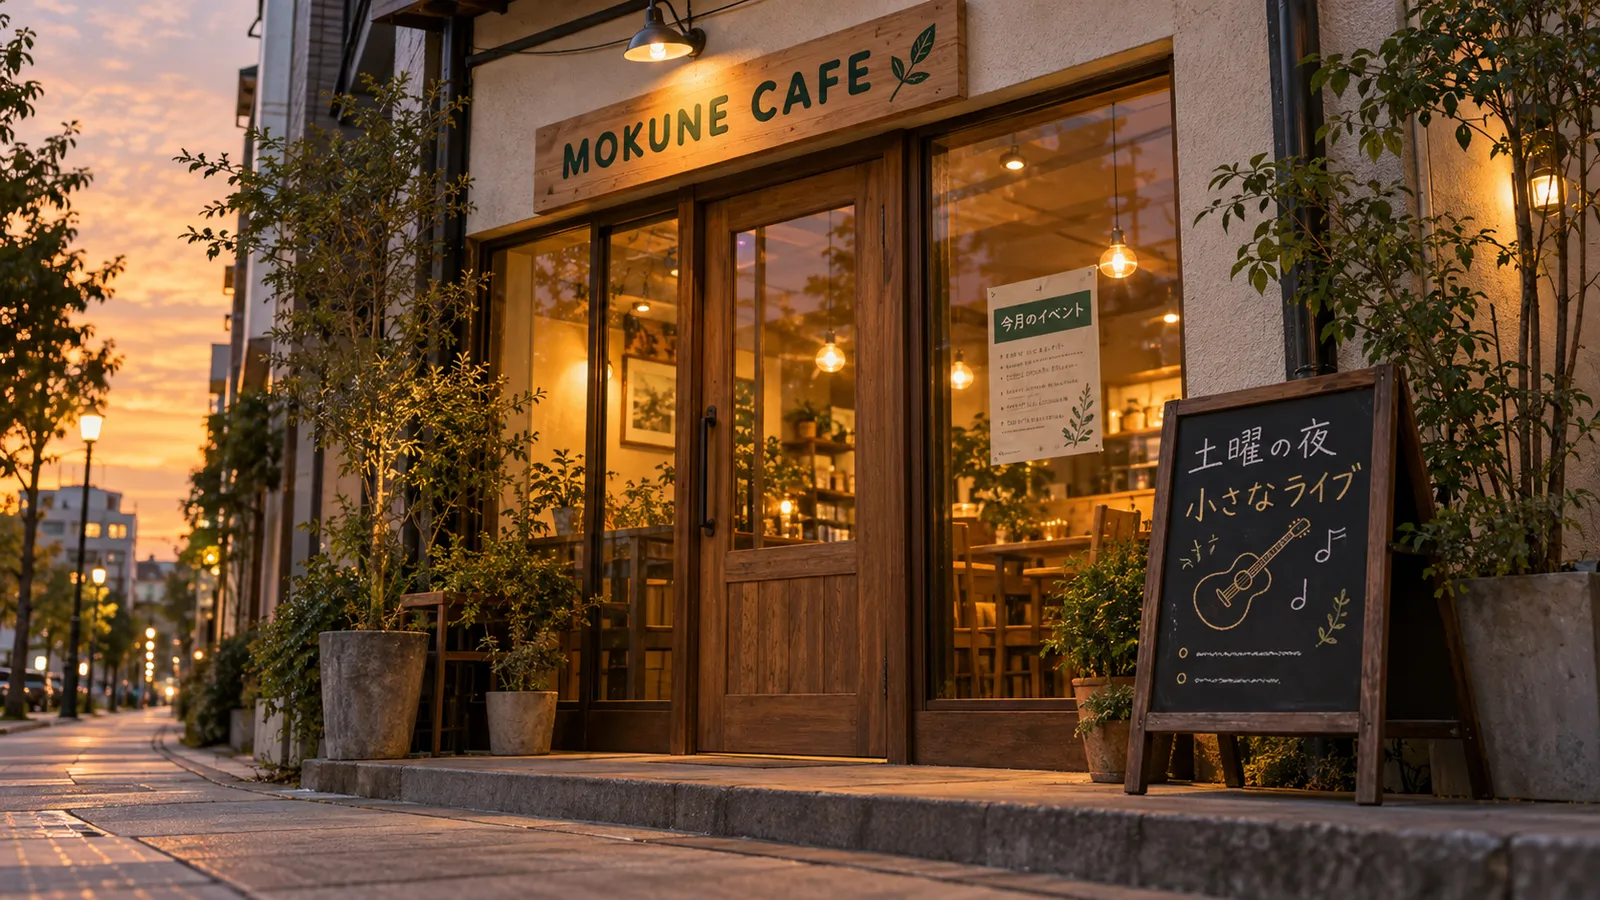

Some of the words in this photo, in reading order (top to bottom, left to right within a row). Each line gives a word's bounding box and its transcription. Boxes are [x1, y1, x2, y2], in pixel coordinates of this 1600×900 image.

[562, 94, 729, 180] MOKUNE
[750, 50, 872, 123] CAFE
[1000, 302, 1084, 332] 今月のイベント
[1188, 418, 1337, 474] 土曜の夜
[1185, 462, 1362, 522] 小さなライブ
